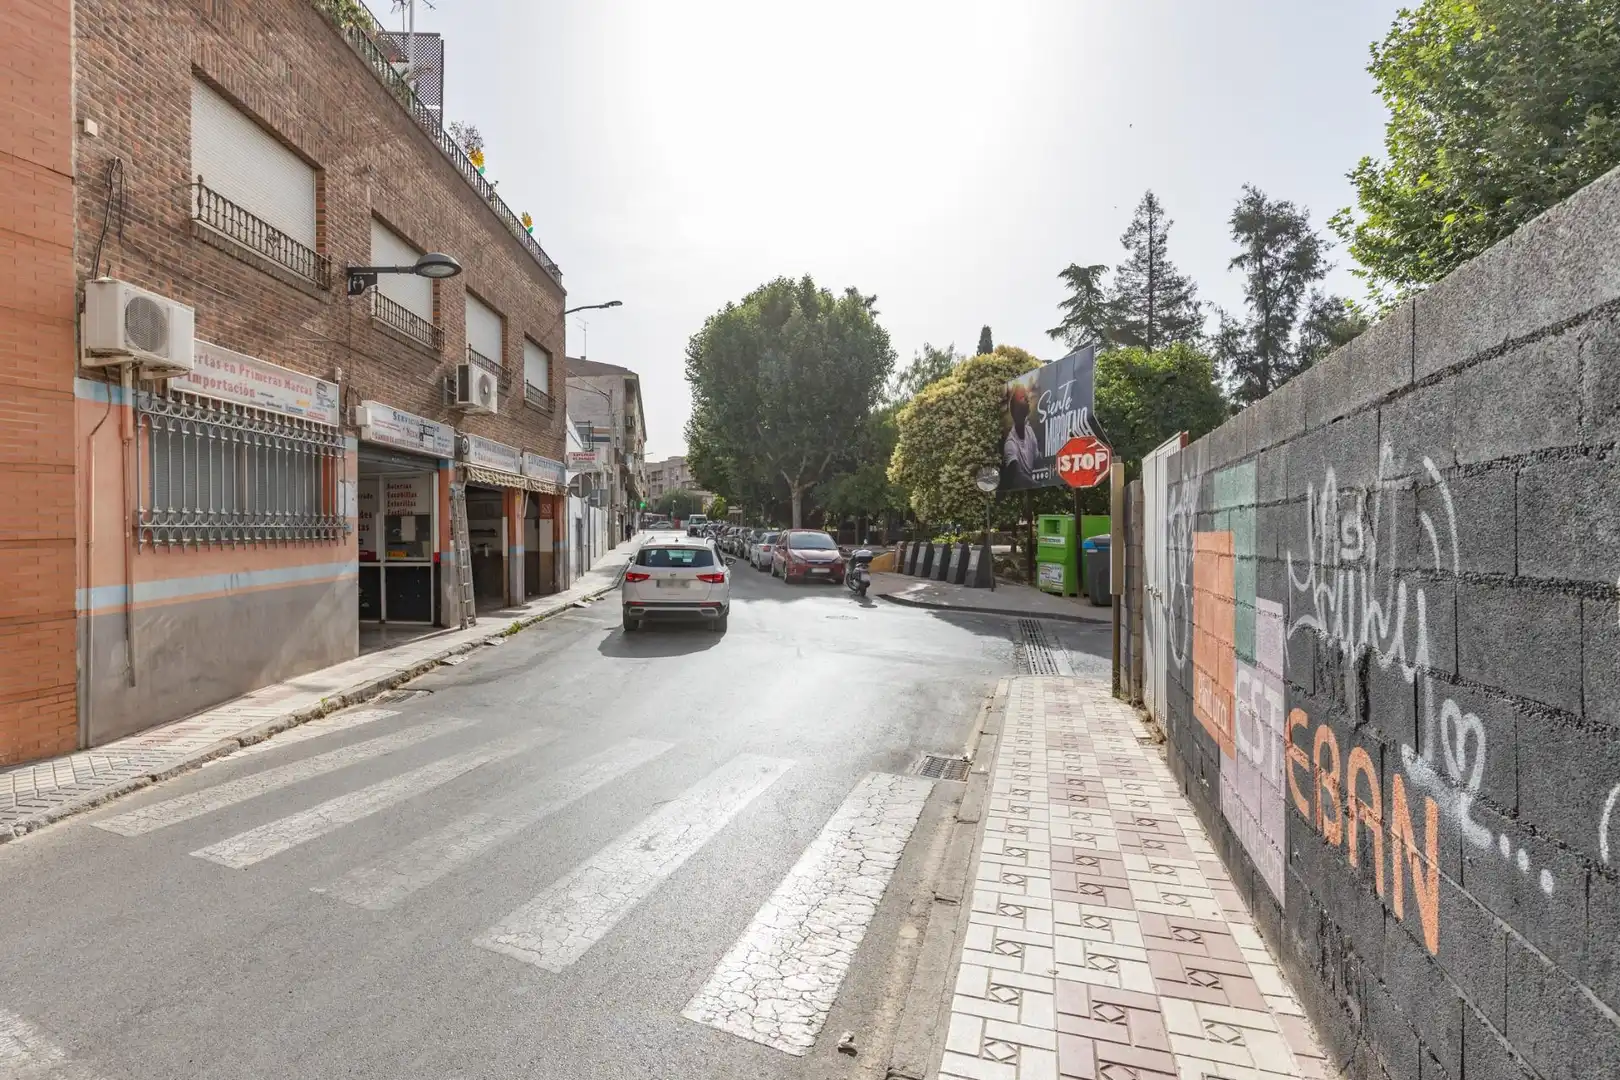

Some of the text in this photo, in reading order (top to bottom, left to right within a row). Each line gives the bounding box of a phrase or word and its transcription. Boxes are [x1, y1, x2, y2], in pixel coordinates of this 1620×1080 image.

[239, 363, 283, 388] Primeras
[284, 379, 313, 397] Marcas
[1037, 379, 1077, 424] Siente
[1060, 451, 1108, 474] STOP
[1237, 668, 1440, 956] ESTEBAN
